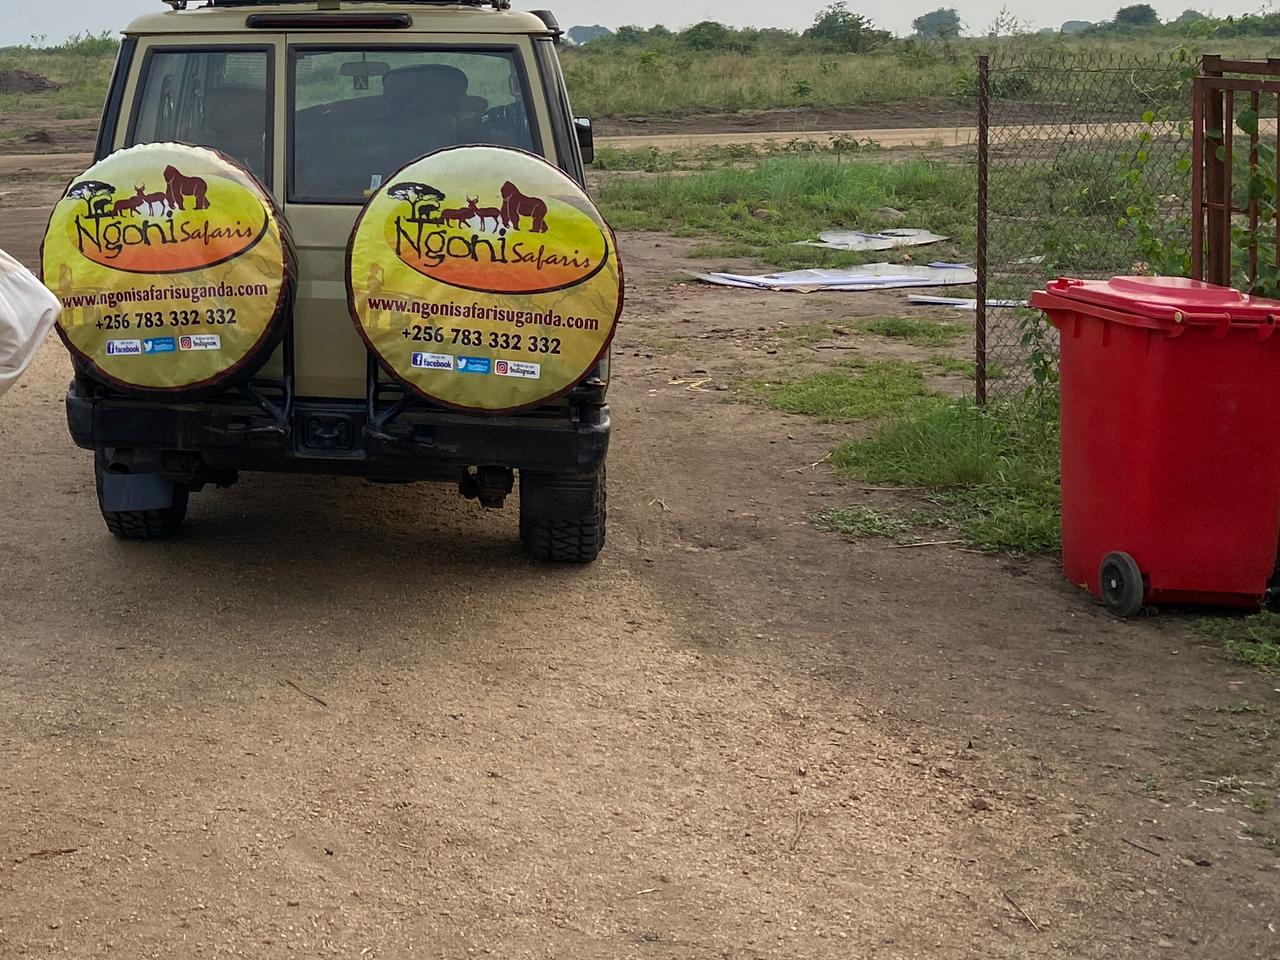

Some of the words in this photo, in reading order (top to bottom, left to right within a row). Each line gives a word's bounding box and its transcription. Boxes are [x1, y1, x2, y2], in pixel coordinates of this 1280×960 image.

[74, 211, 178, 259] Ngoni
[180, 220, 253, 246] Safaris
[394, 216, 508, 268] Ngoni
[510, 242, 591, 271] Safaris
[61, 281, 268, 309] www.ngonisafarisuganda.com
[95, 313, 130, 330] +256
[135, 311, 164, 329] 783
[169, 309, 200, 327] 332
[205, 308, 237, 325] 332
[367, 297, 599, 331] www.ngonisafarisuganda.com
[115, 344, 140, 354] facebook
[401, 325, 444, 344] +256
[450, 328, 483, 347] 783
[488, 331, 522, 351] 332
[527, 335, 561, 355] 332
[422, 358, 452, 369] facebook
